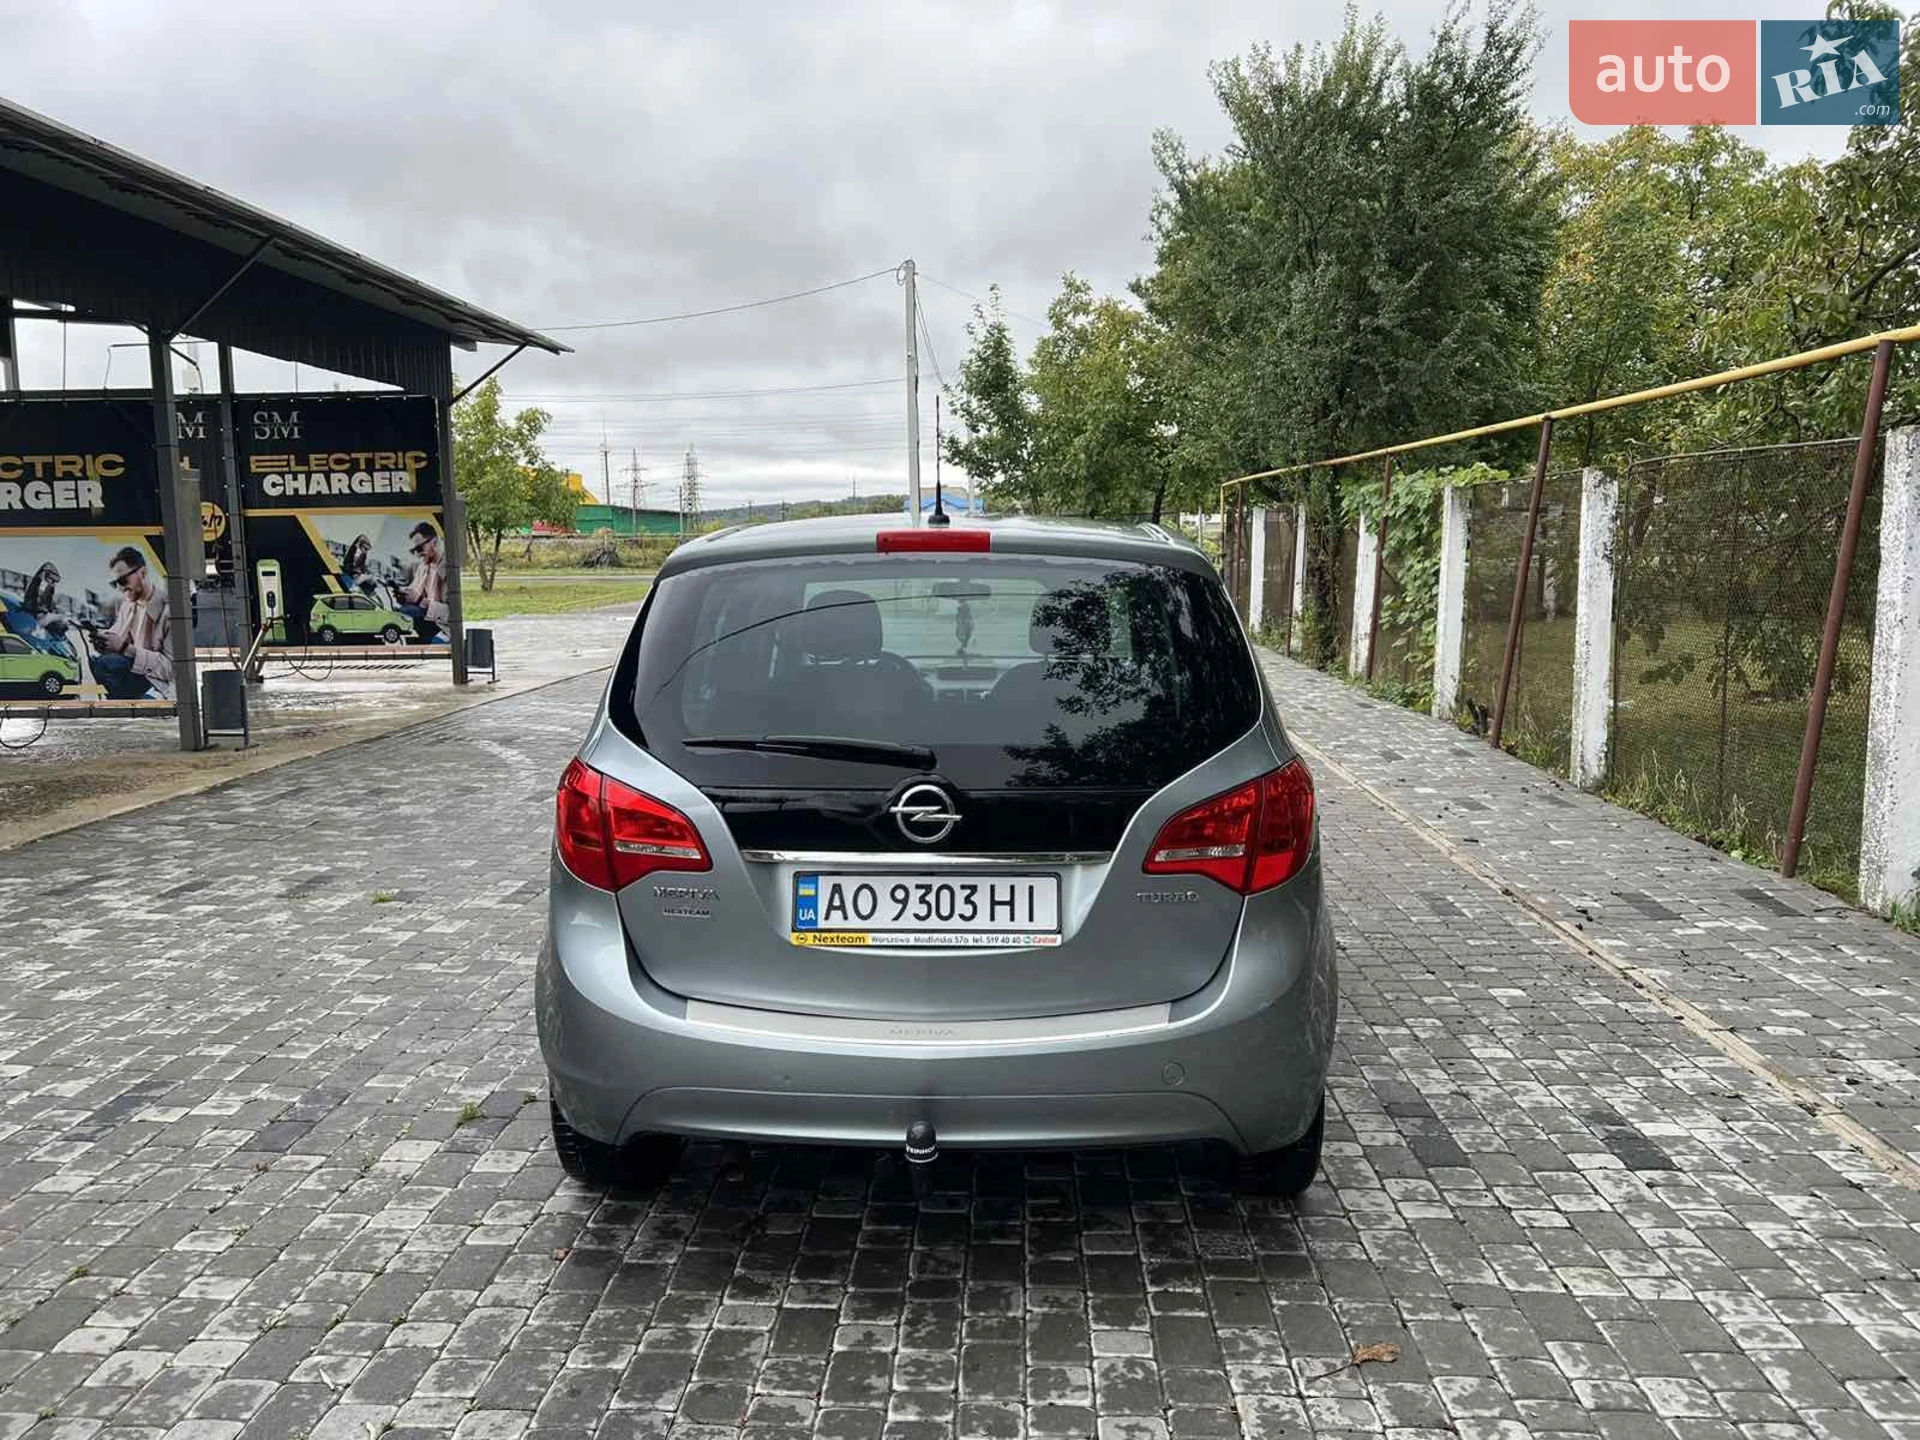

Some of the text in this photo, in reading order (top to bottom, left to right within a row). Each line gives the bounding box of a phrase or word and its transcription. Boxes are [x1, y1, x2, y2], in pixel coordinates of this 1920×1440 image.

[253, 411, 301, 440] SM
[250, 450, 428, 473] ELECTRIC
[262, 471, 412, 496] CHARGER
[824, 883, 1034, 922] AO 9303 HI
[1133, 891, 1200, 903] TURBO
[799, 909, 816, 921] UA
[812, 934, 866, 944] Nexteam
